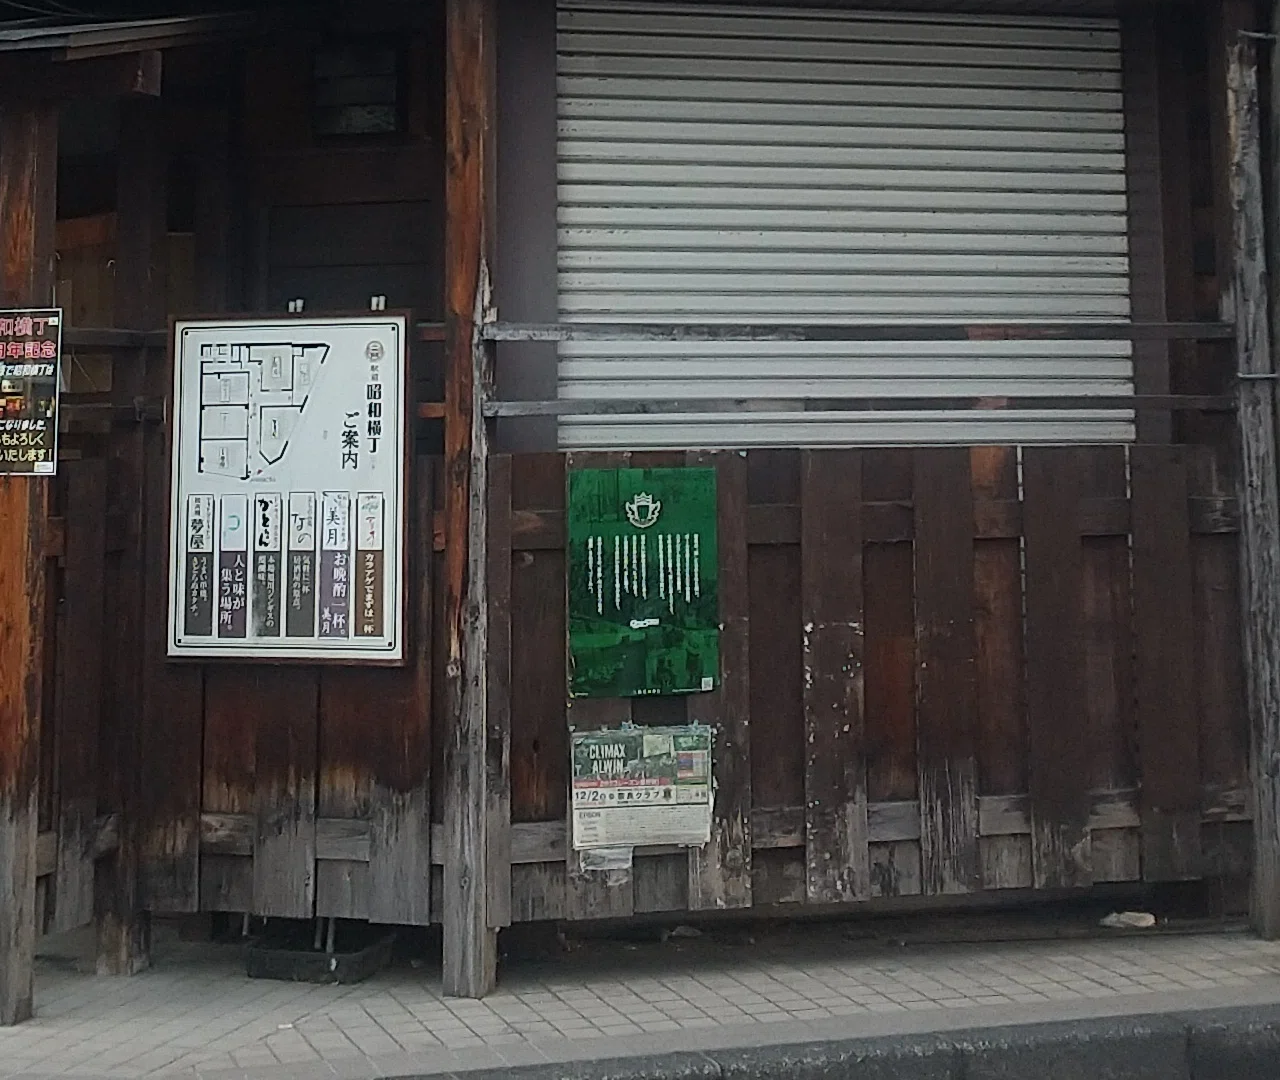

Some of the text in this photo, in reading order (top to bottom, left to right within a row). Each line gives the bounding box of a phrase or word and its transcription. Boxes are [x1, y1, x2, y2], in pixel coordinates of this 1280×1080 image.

[341, 411, 360, 470] ご案内
[367, 384, 382, 453] 昭和横丁
[326, 506, 340, 546] 美月
[233, 554, 245, 610] 人と味が
[589, 744, 626, 759] CLIMAX
